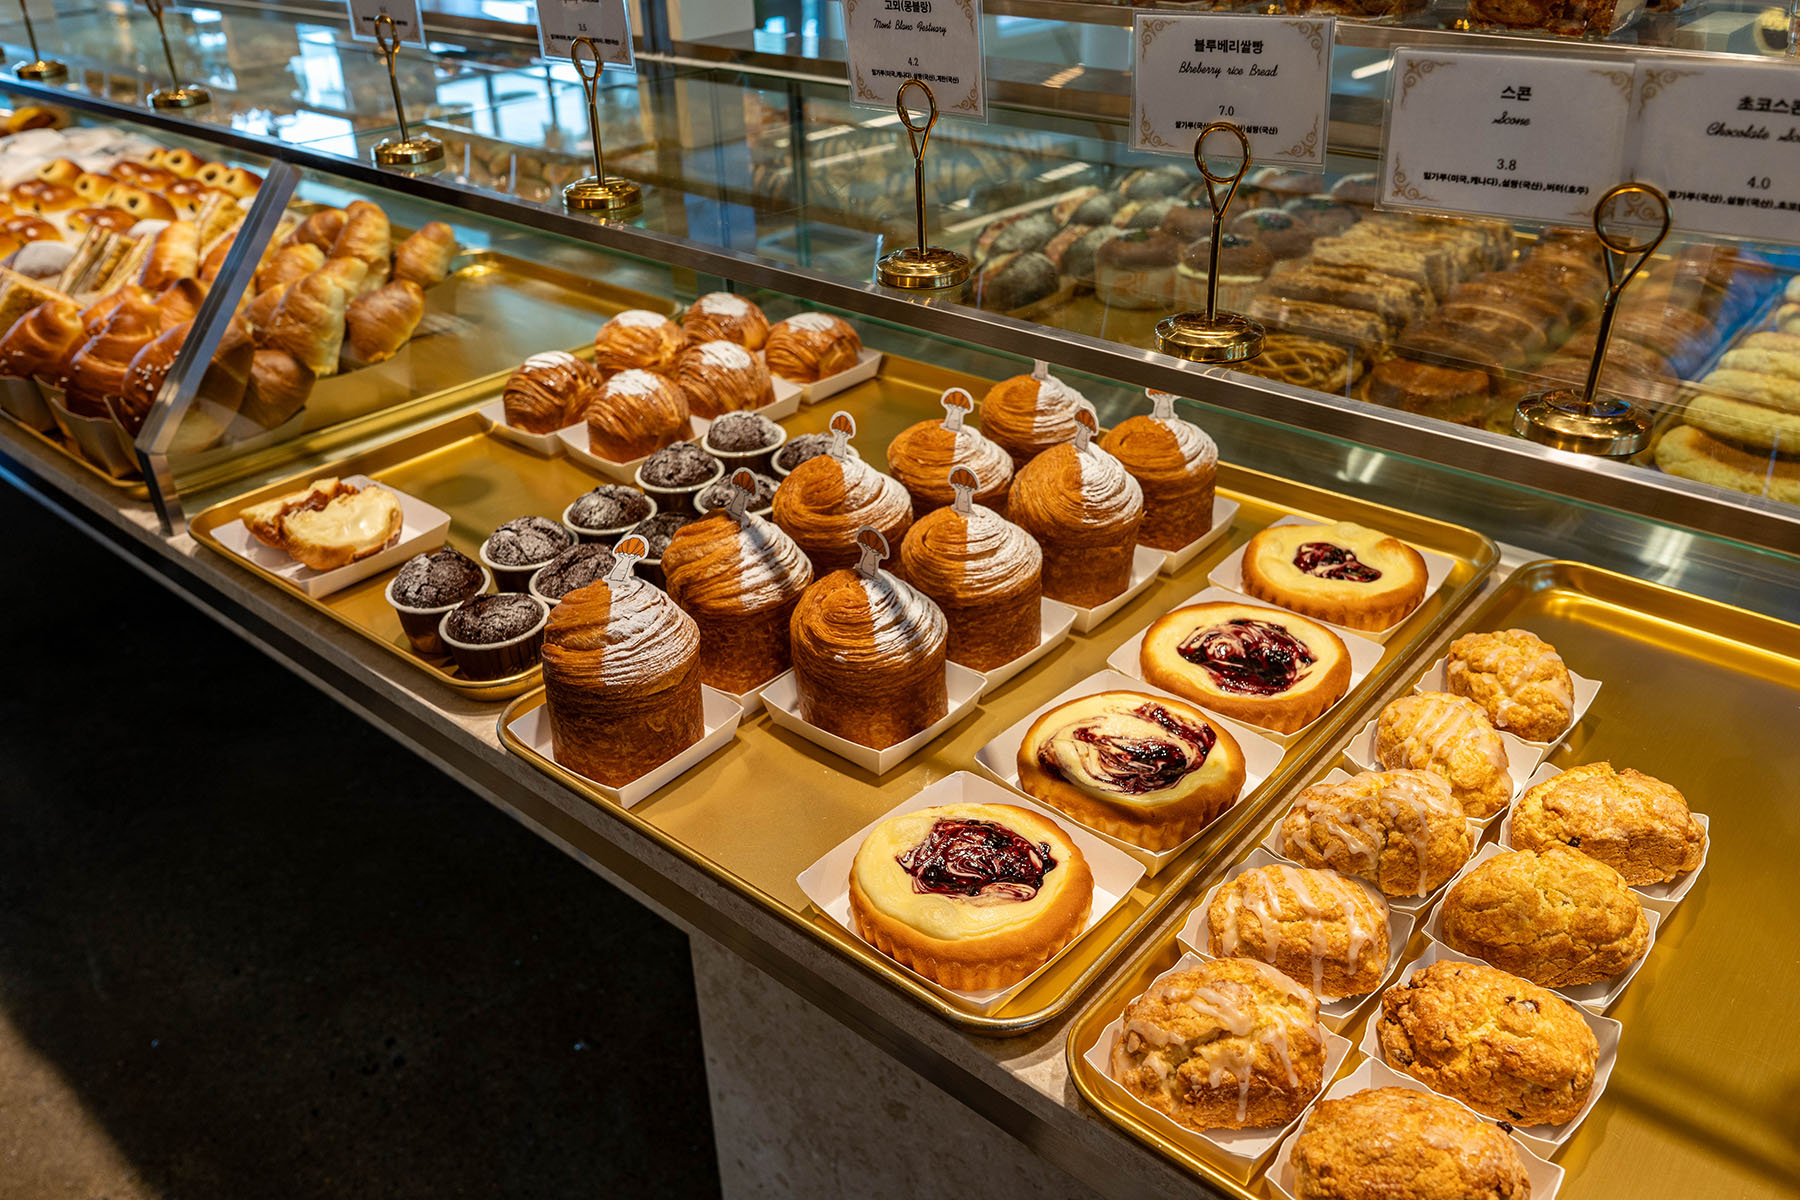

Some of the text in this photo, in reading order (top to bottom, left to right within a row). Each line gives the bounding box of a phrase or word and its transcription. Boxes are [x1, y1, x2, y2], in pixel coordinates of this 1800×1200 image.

[873, 18, 892, 30] Mont
[895, 20, 914, 31] Blanc
[1194, 39, 1264, 54] 블루베리쌀빵
[907, 57, 919, 66] 4.2
[1227, 65, 1244, 76] rice
[1249, 64, 1279, 77] Bread
[1500, 85, 1532, 102] 스콘
[1218, 105, 1235, 116] 7.0
[1491, 110, 1531, 126] Scone
[1706, 121, 1770, 140] Chocolate
[1496, 158, 1517, 171] 3.8
[1746, 176, 1771, 190] 4.0
